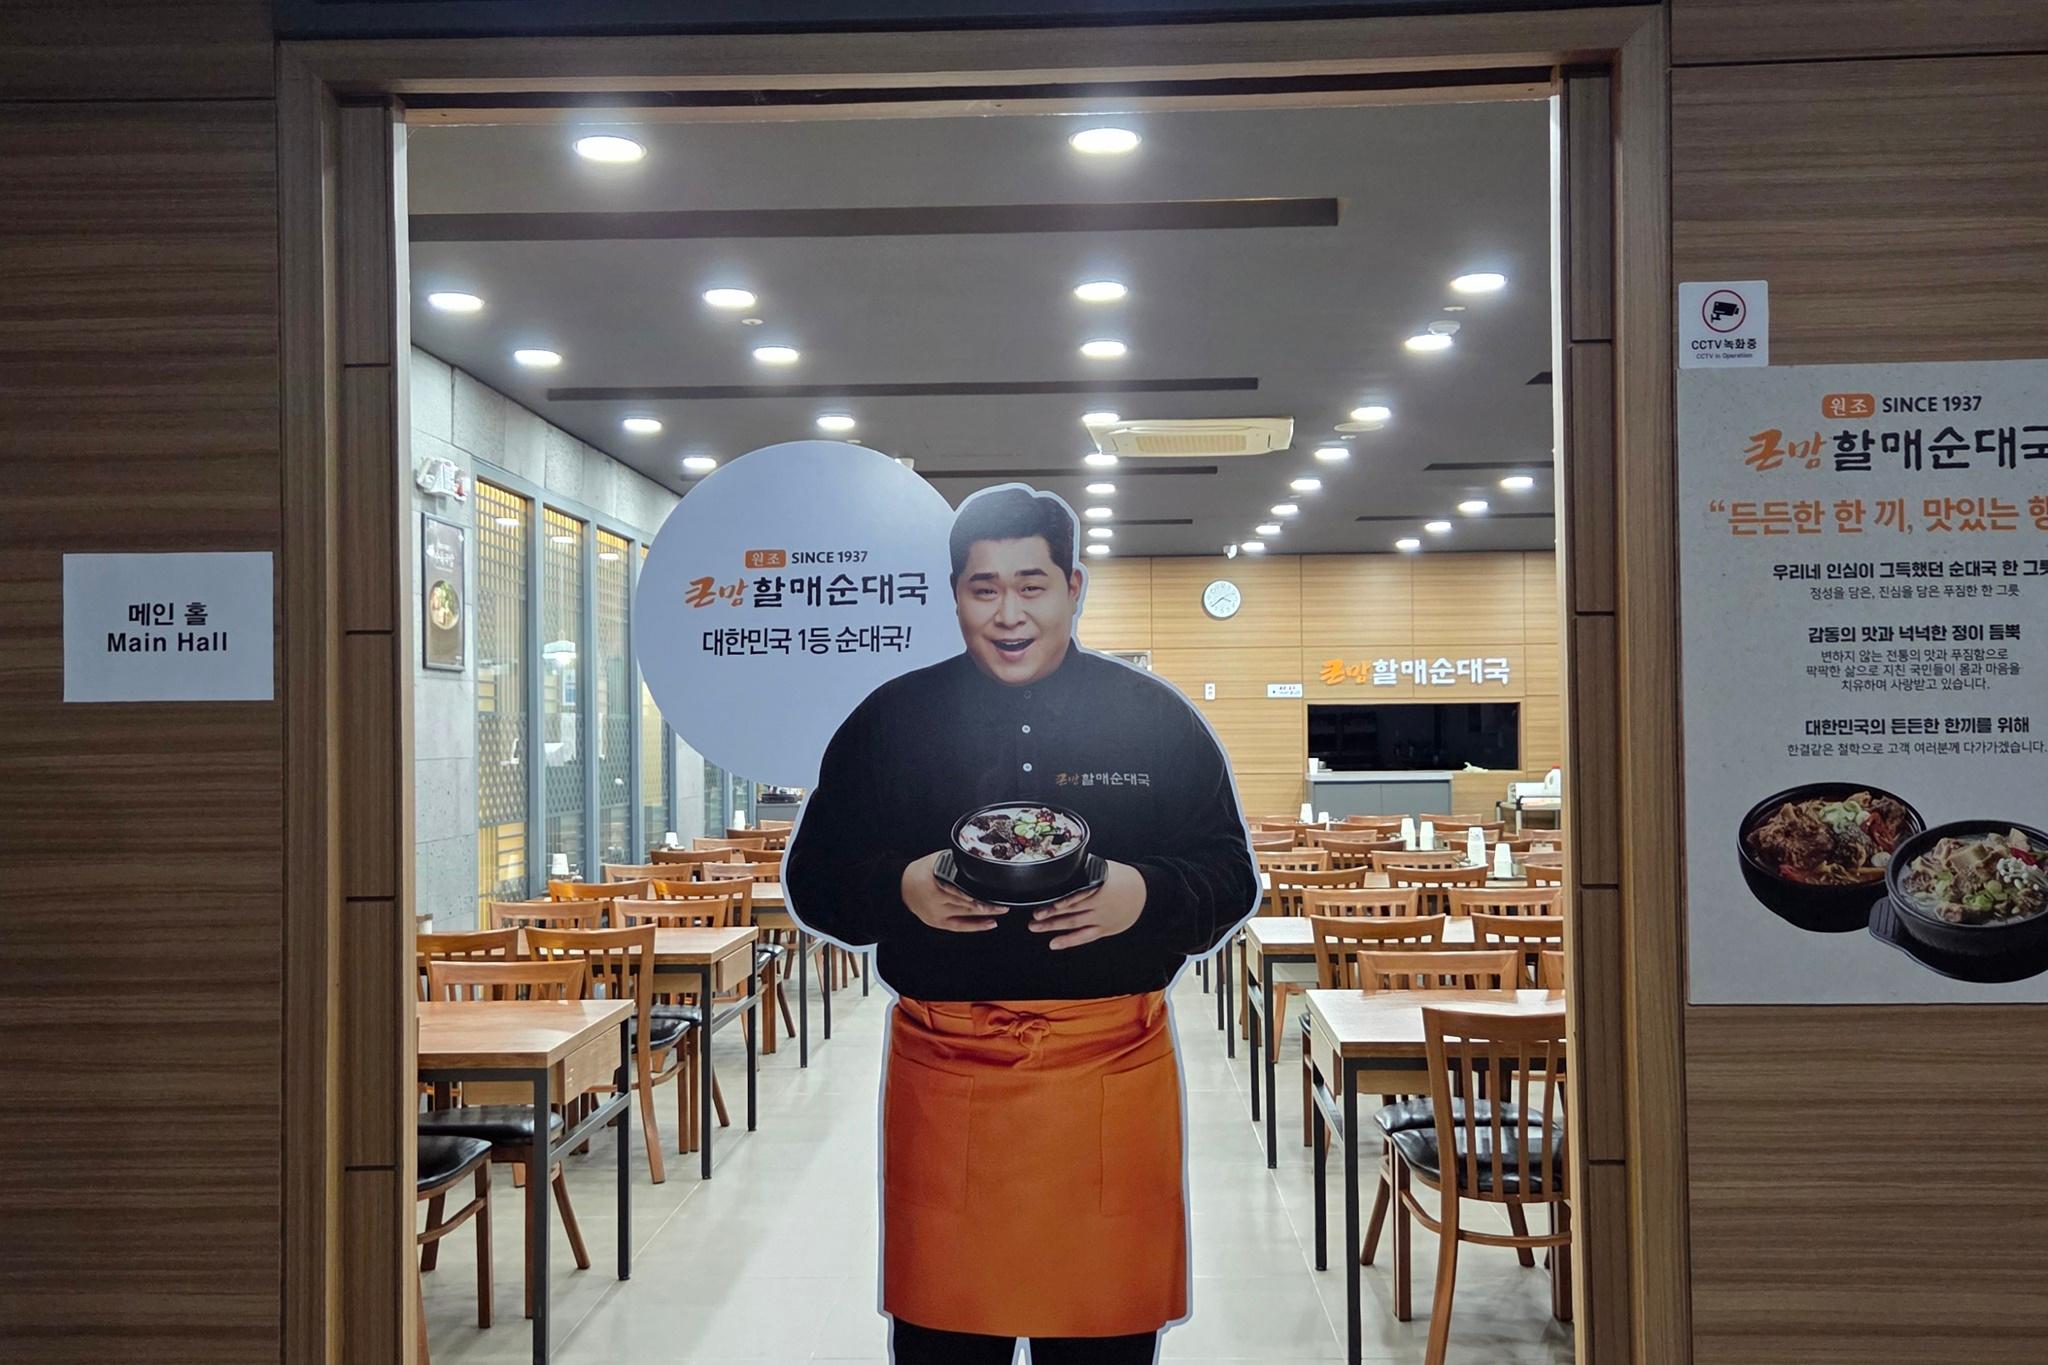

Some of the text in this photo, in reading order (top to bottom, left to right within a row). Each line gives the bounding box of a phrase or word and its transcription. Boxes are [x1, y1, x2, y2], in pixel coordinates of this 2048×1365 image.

[1692, 340, 1721, 350] CCTV
[1829, 396, 1982, 417] 원조 SINCE 1937
[1833, 498, 1866, 534] 한
[1922, 497, 2020, 532] 맛있는
[791, 552, 834, 564] SINCE
[837, 550, 868, 563] 1937
[1772, 563, 1821, 580] 우리네
[1826, 562, 1874, 580] 인심이
[1879, 561, 1944, 578] 그득했던
[1949, 560, 1997, 578] 순대국
[2002, 560, 2018, 576] 한
[1810, 584, 2020, 600] 정성을 담은, 진심을 담은 푸짐한 한 그릇
[128, 601, 208, 626] 메인 홀
[107, 632, 228, 652] Main Hall
[702, 624, 912, 656] 대한민국 1등 순대국!
[1808, 624, 2020, 644] 감동의 맛과 넉넉한 정이 듬뿍
[1821, 648, 2008, 664] 변하지 않는 전통의 맛과 푸짐함으로
[1844, 664, 1880, 678] 삶으로
[1883, 664, 1906, 677] 지친
[1960, 662, 1982, 676] 몸과
[1986, 662, 2021, 676] 마음을
[1841, 678, 1990, 692] 치유하며 사랑받고 있습니다.
[1806, 716, 2030, 736] 대한민국의 든든한 한끼를 위해
[1788, 740, 2048, 757] 한결같은 철학으로 고객 여러분께 다가가겠습니다.
